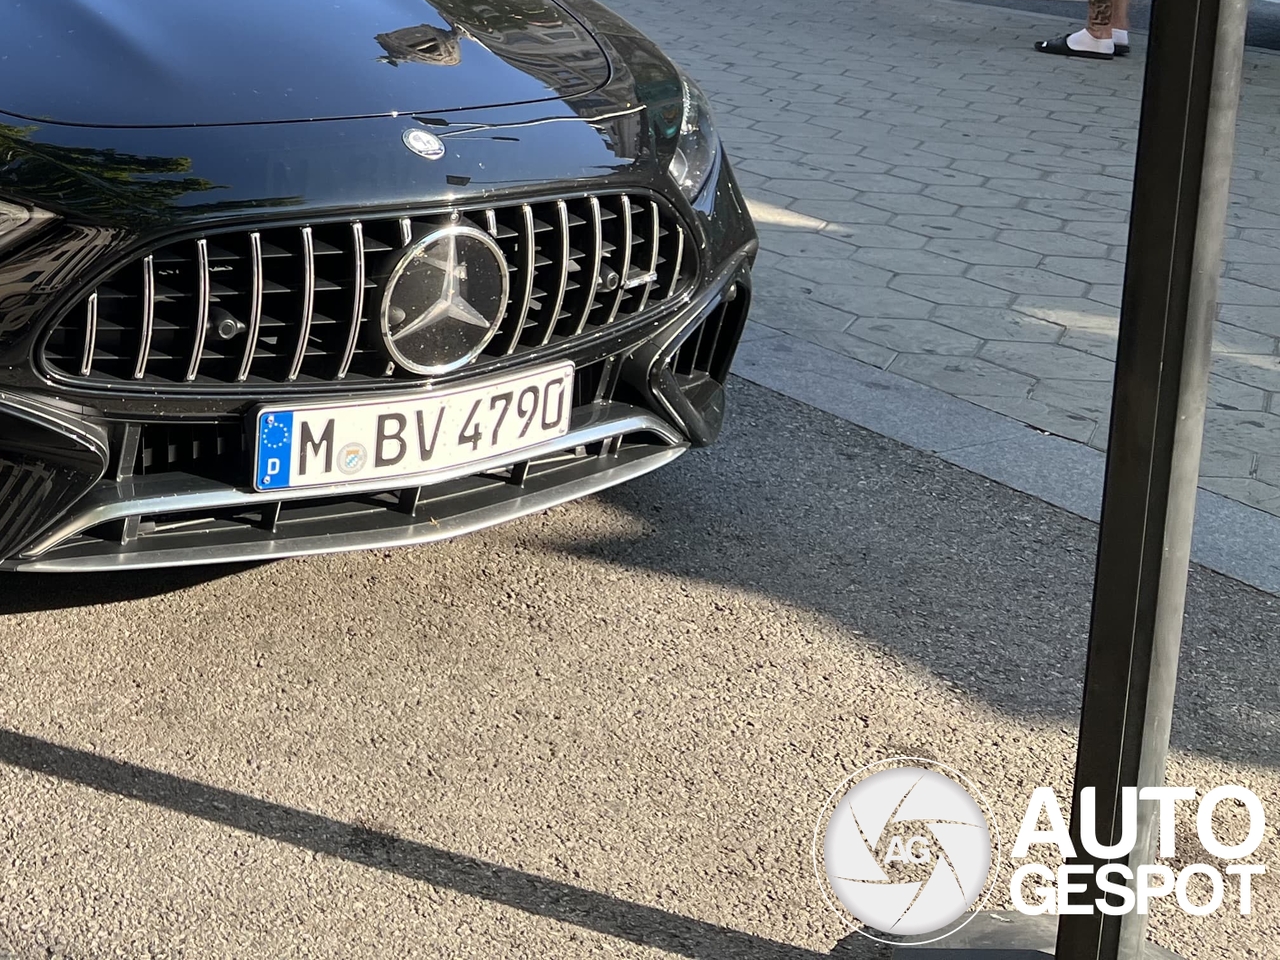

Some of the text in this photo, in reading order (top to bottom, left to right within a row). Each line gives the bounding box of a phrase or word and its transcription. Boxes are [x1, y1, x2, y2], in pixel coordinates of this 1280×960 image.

[298, 377, 565, 476] M BV 4790
[267, 458, 280, 475] D
